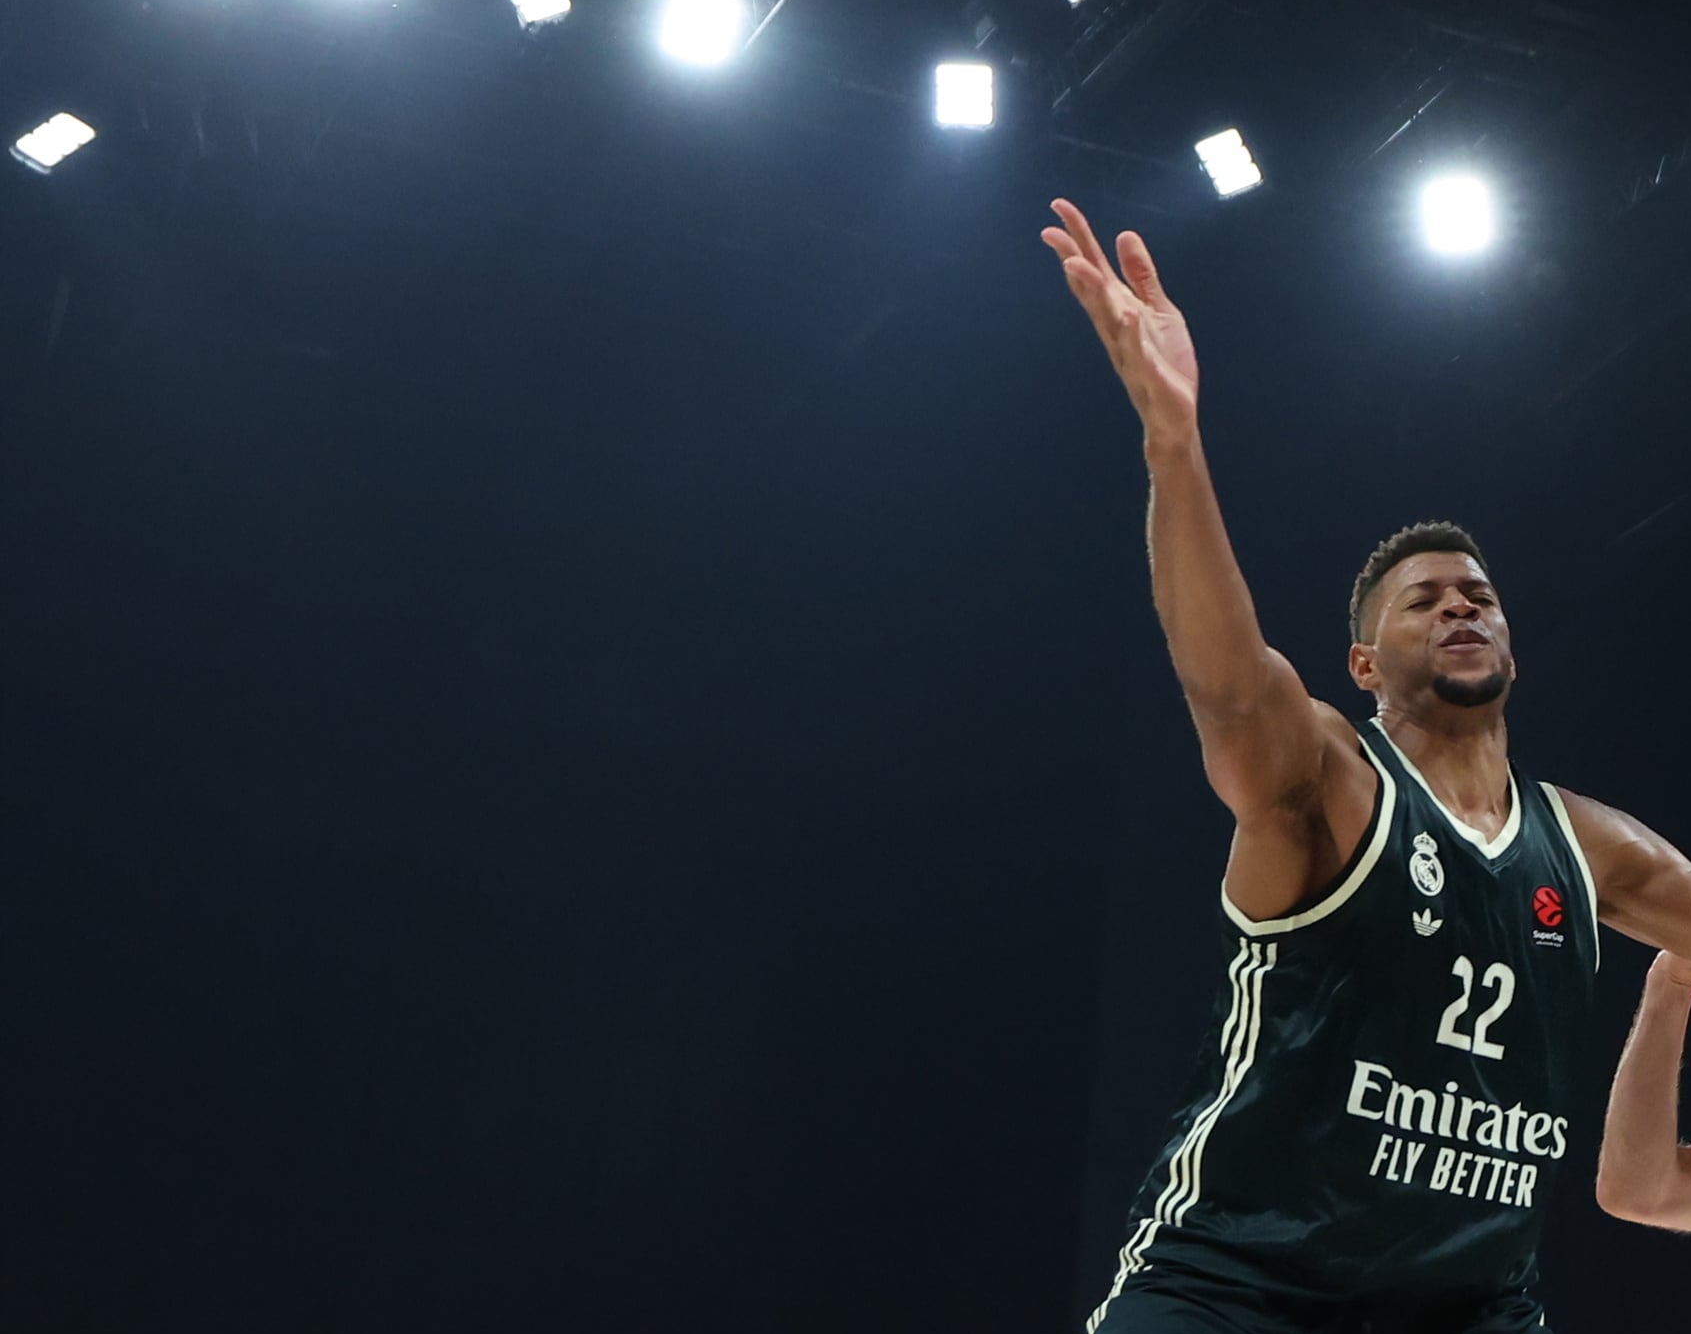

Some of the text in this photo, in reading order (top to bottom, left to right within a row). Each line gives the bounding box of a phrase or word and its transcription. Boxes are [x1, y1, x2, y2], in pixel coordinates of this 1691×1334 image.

[1436, 955, 1516, 1060] 22
[1346, 1059, 1568, 1159] Emirates
[1369, 1133, 1538, 1208] FLY BETTER
